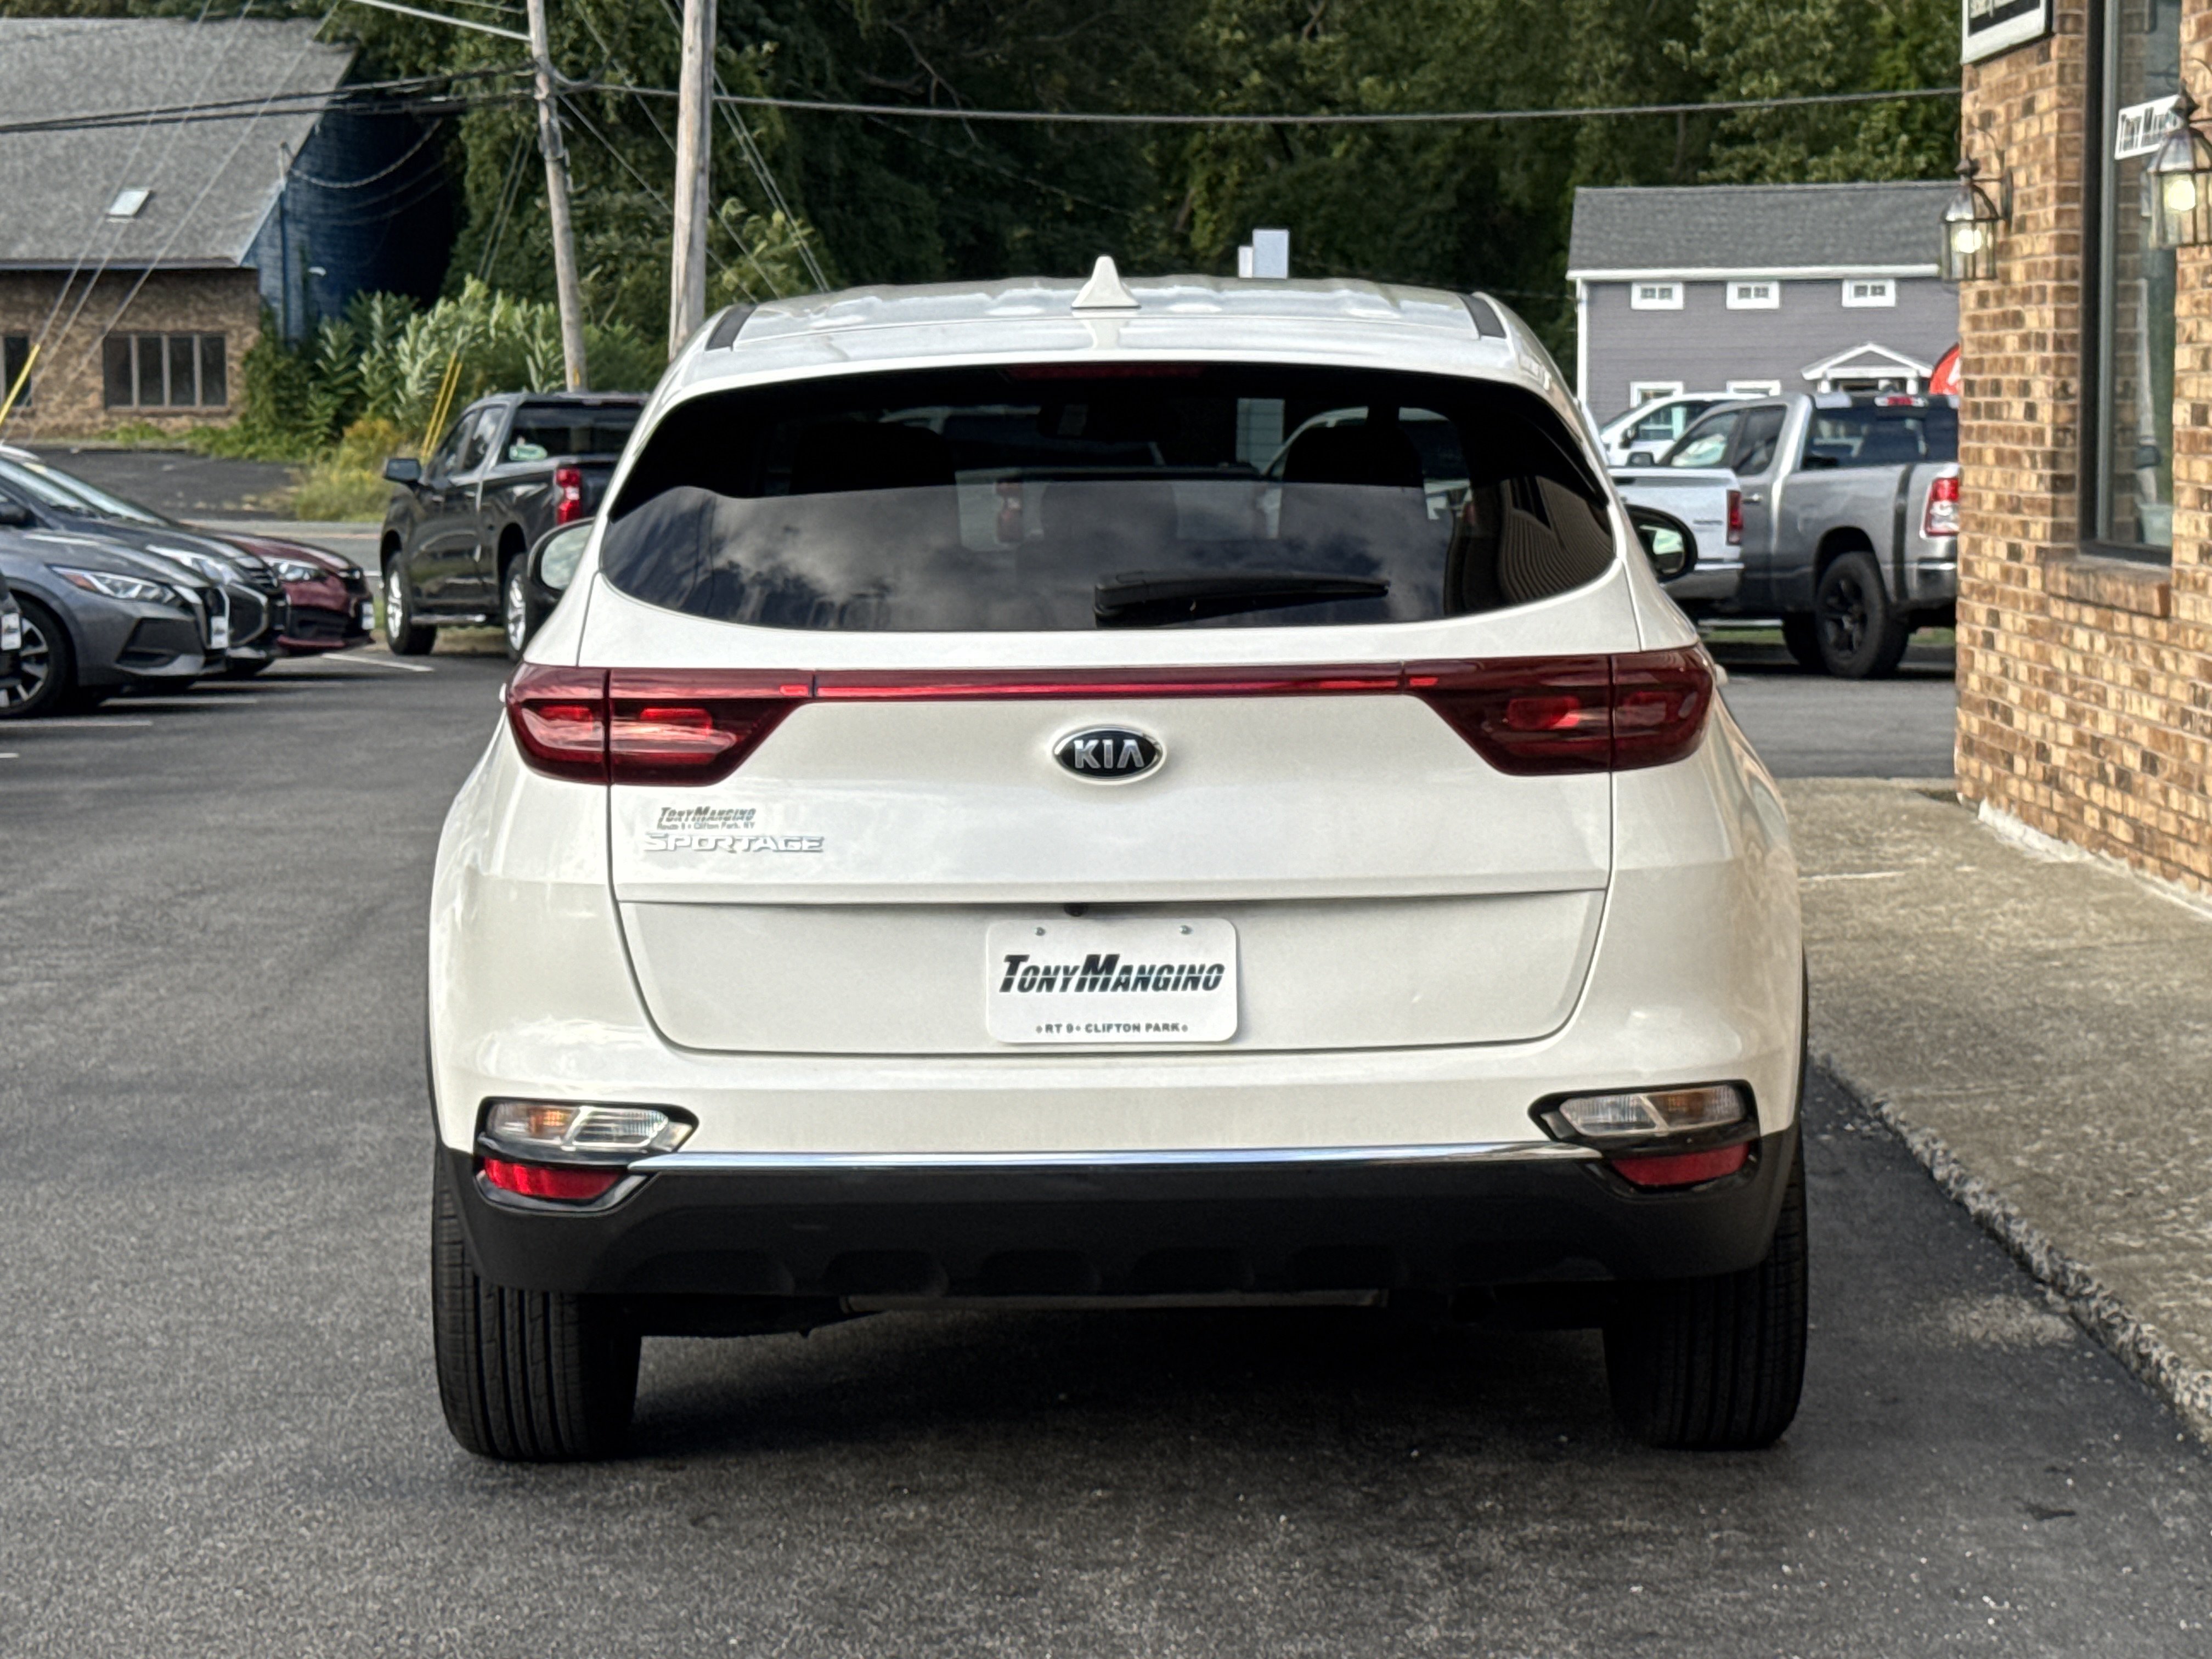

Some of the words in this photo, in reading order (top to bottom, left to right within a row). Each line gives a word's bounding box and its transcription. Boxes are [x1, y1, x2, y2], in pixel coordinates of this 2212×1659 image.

[1074, 739, 1144, 769] KIA
[645, 833, 825, 852] SPORTAGE
[1045, 1024, 1063, 1033] RT
[1085, 1023, 1141, 1033] CLIFTON
[1145, 1023, 1180, 1032] PARK
